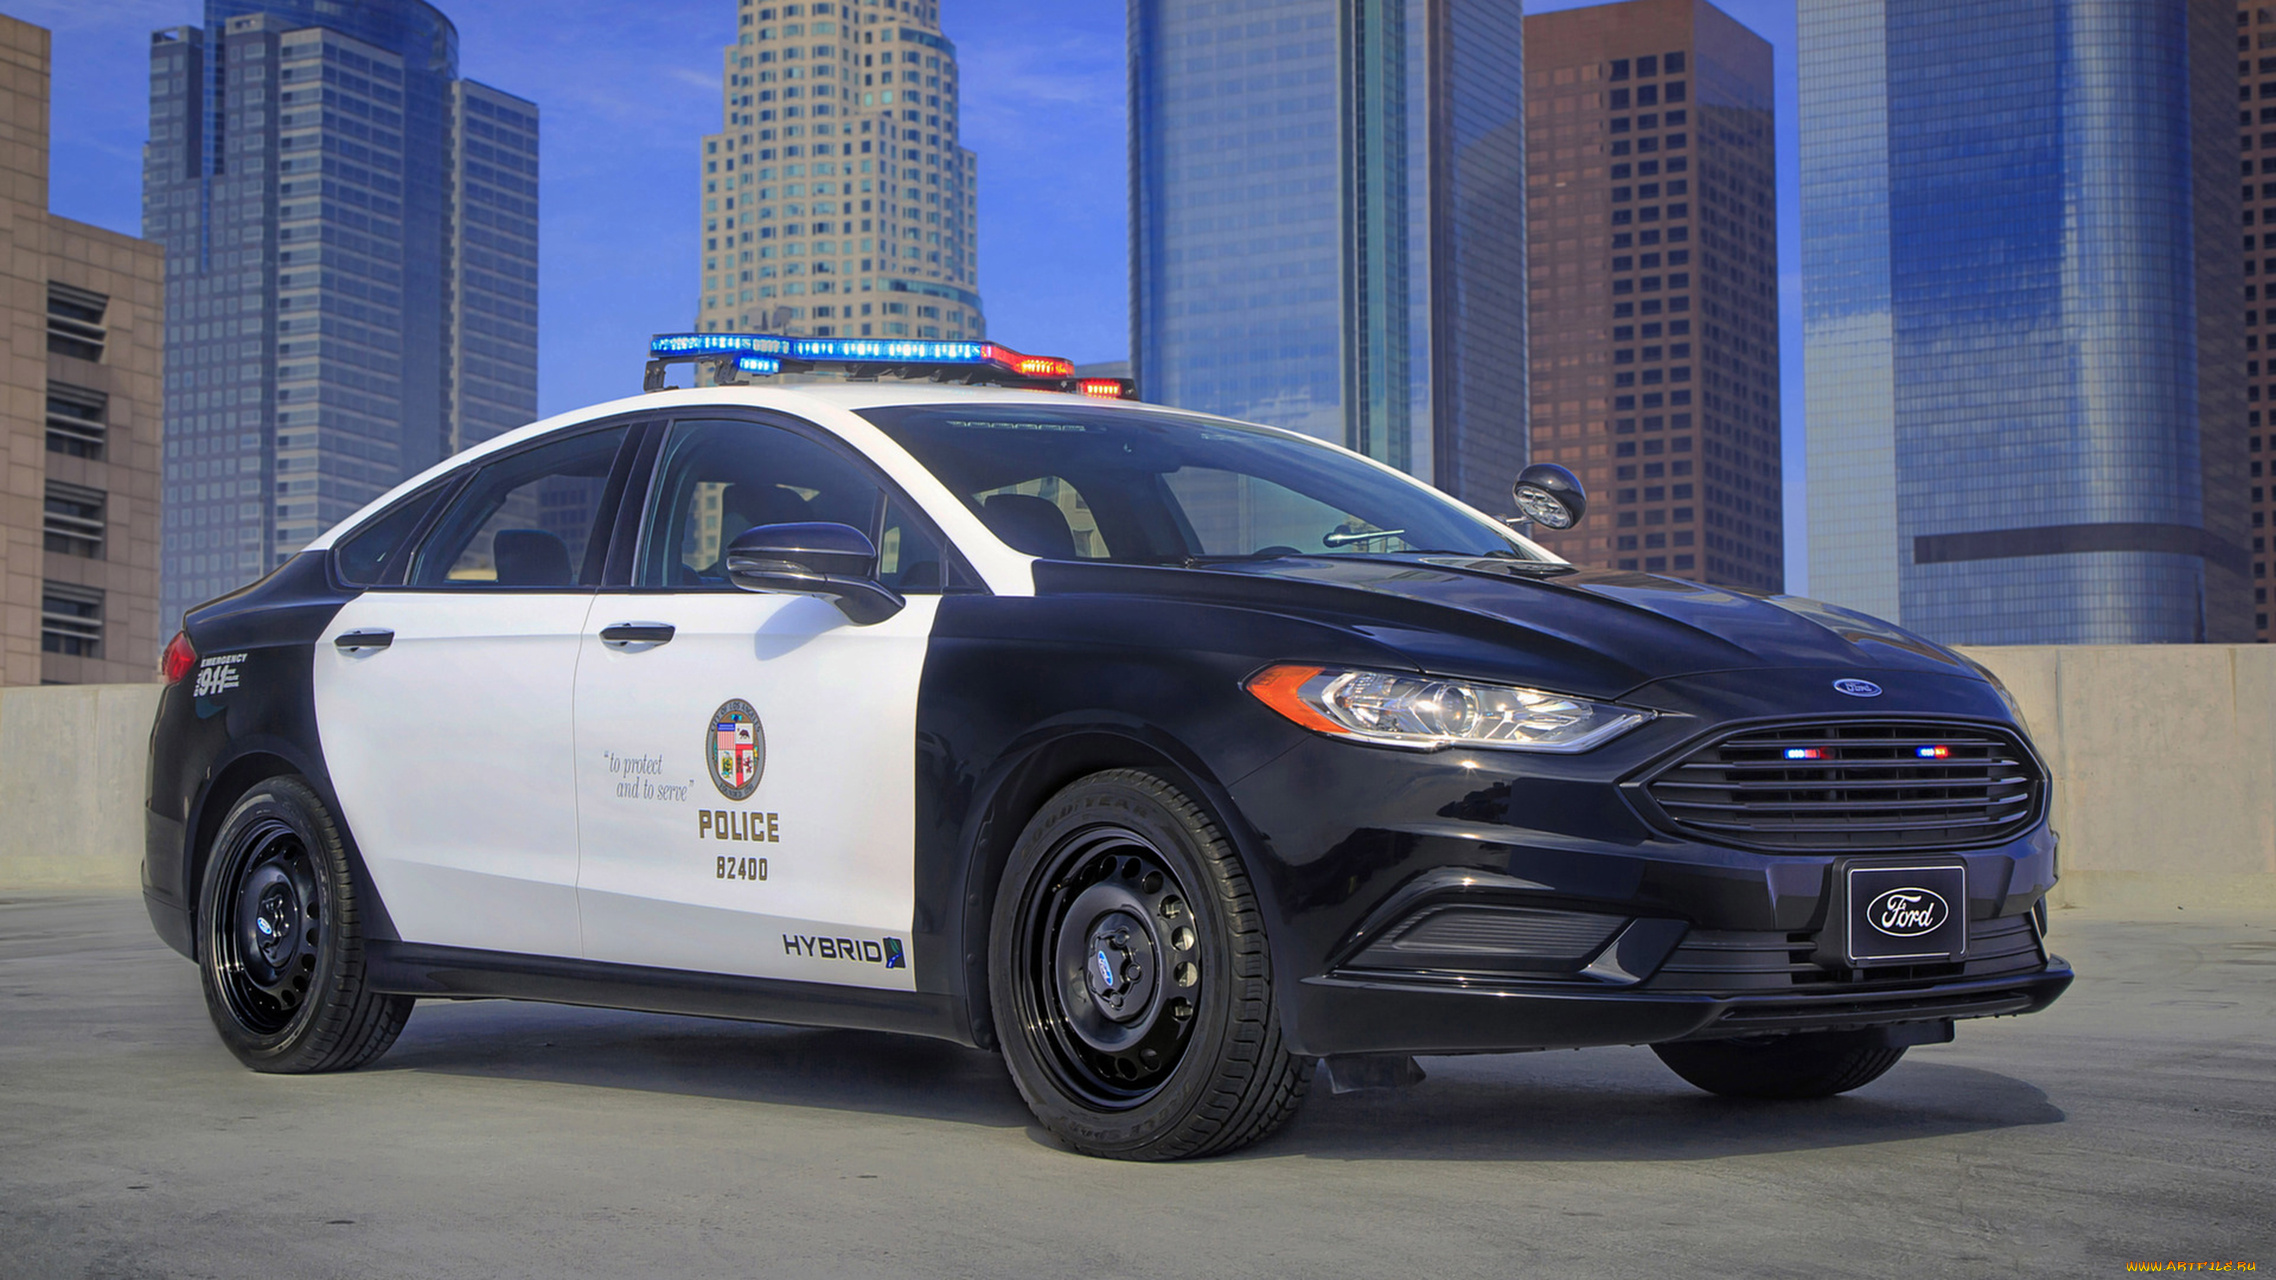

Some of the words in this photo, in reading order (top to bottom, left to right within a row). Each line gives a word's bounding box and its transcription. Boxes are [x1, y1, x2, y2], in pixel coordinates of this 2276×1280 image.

[200, 653, 248, 668] EMERGENCY
[729, 701, 741, 711] LOS
[623, 753, 663, 779] protect
[616, 775, 640, 799] and
[643, 778, 655, 800] to
[698, 809, 780, 843] POLICE
[716, 855, 768, 881] 82400
[1881, 893, 1935, 928] Ford
[782, 933, 883, 963] HYBRID
